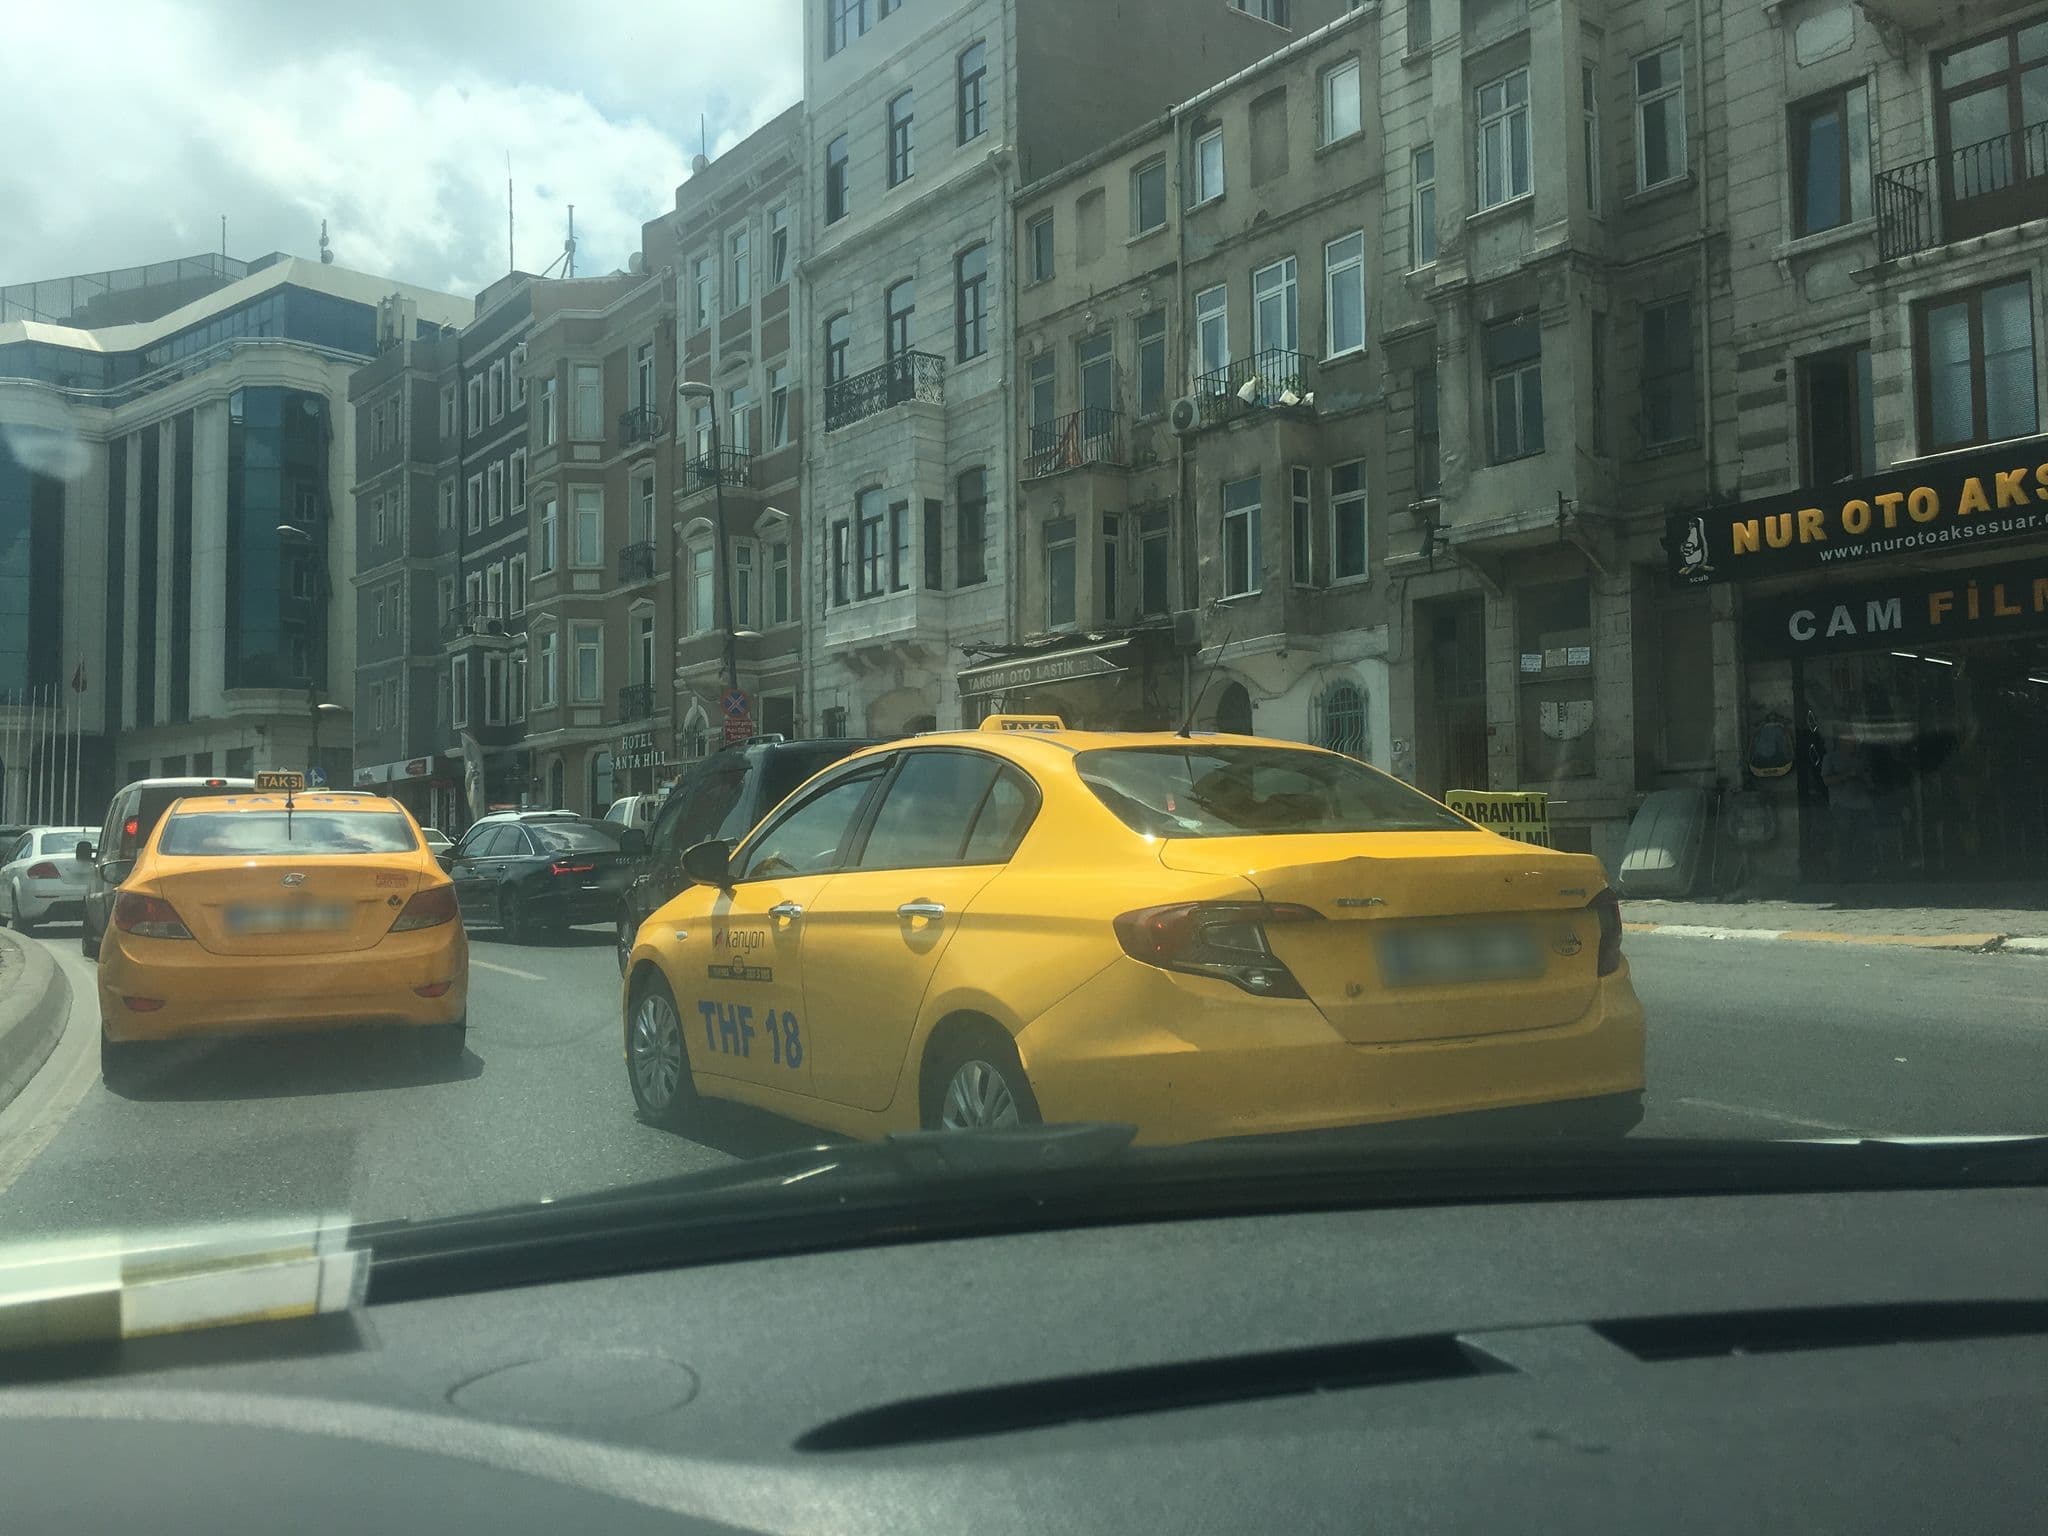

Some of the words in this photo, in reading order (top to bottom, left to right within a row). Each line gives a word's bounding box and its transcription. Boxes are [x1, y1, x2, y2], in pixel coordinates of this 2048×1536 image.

[1732, 508, 1827, 555] NUR
[1841, 486, 1940, 536] OTO
[1820, 513, 2048, 562] www.nurotoaksesuar.
[1788, 597, 1903, 642] CAM
[1009, 668, 1032, 684] OTO
[1036, 658, 1075, 680] LASTİK
[622, 733, 653, 750] HOTEL
[610, 754, 640, 770] SANTA
[1450, 797, 1547, 823] GARANTİLİ
[698, 1000, 756, 1059] THF
[765, 1008, 804, 1069] 18
